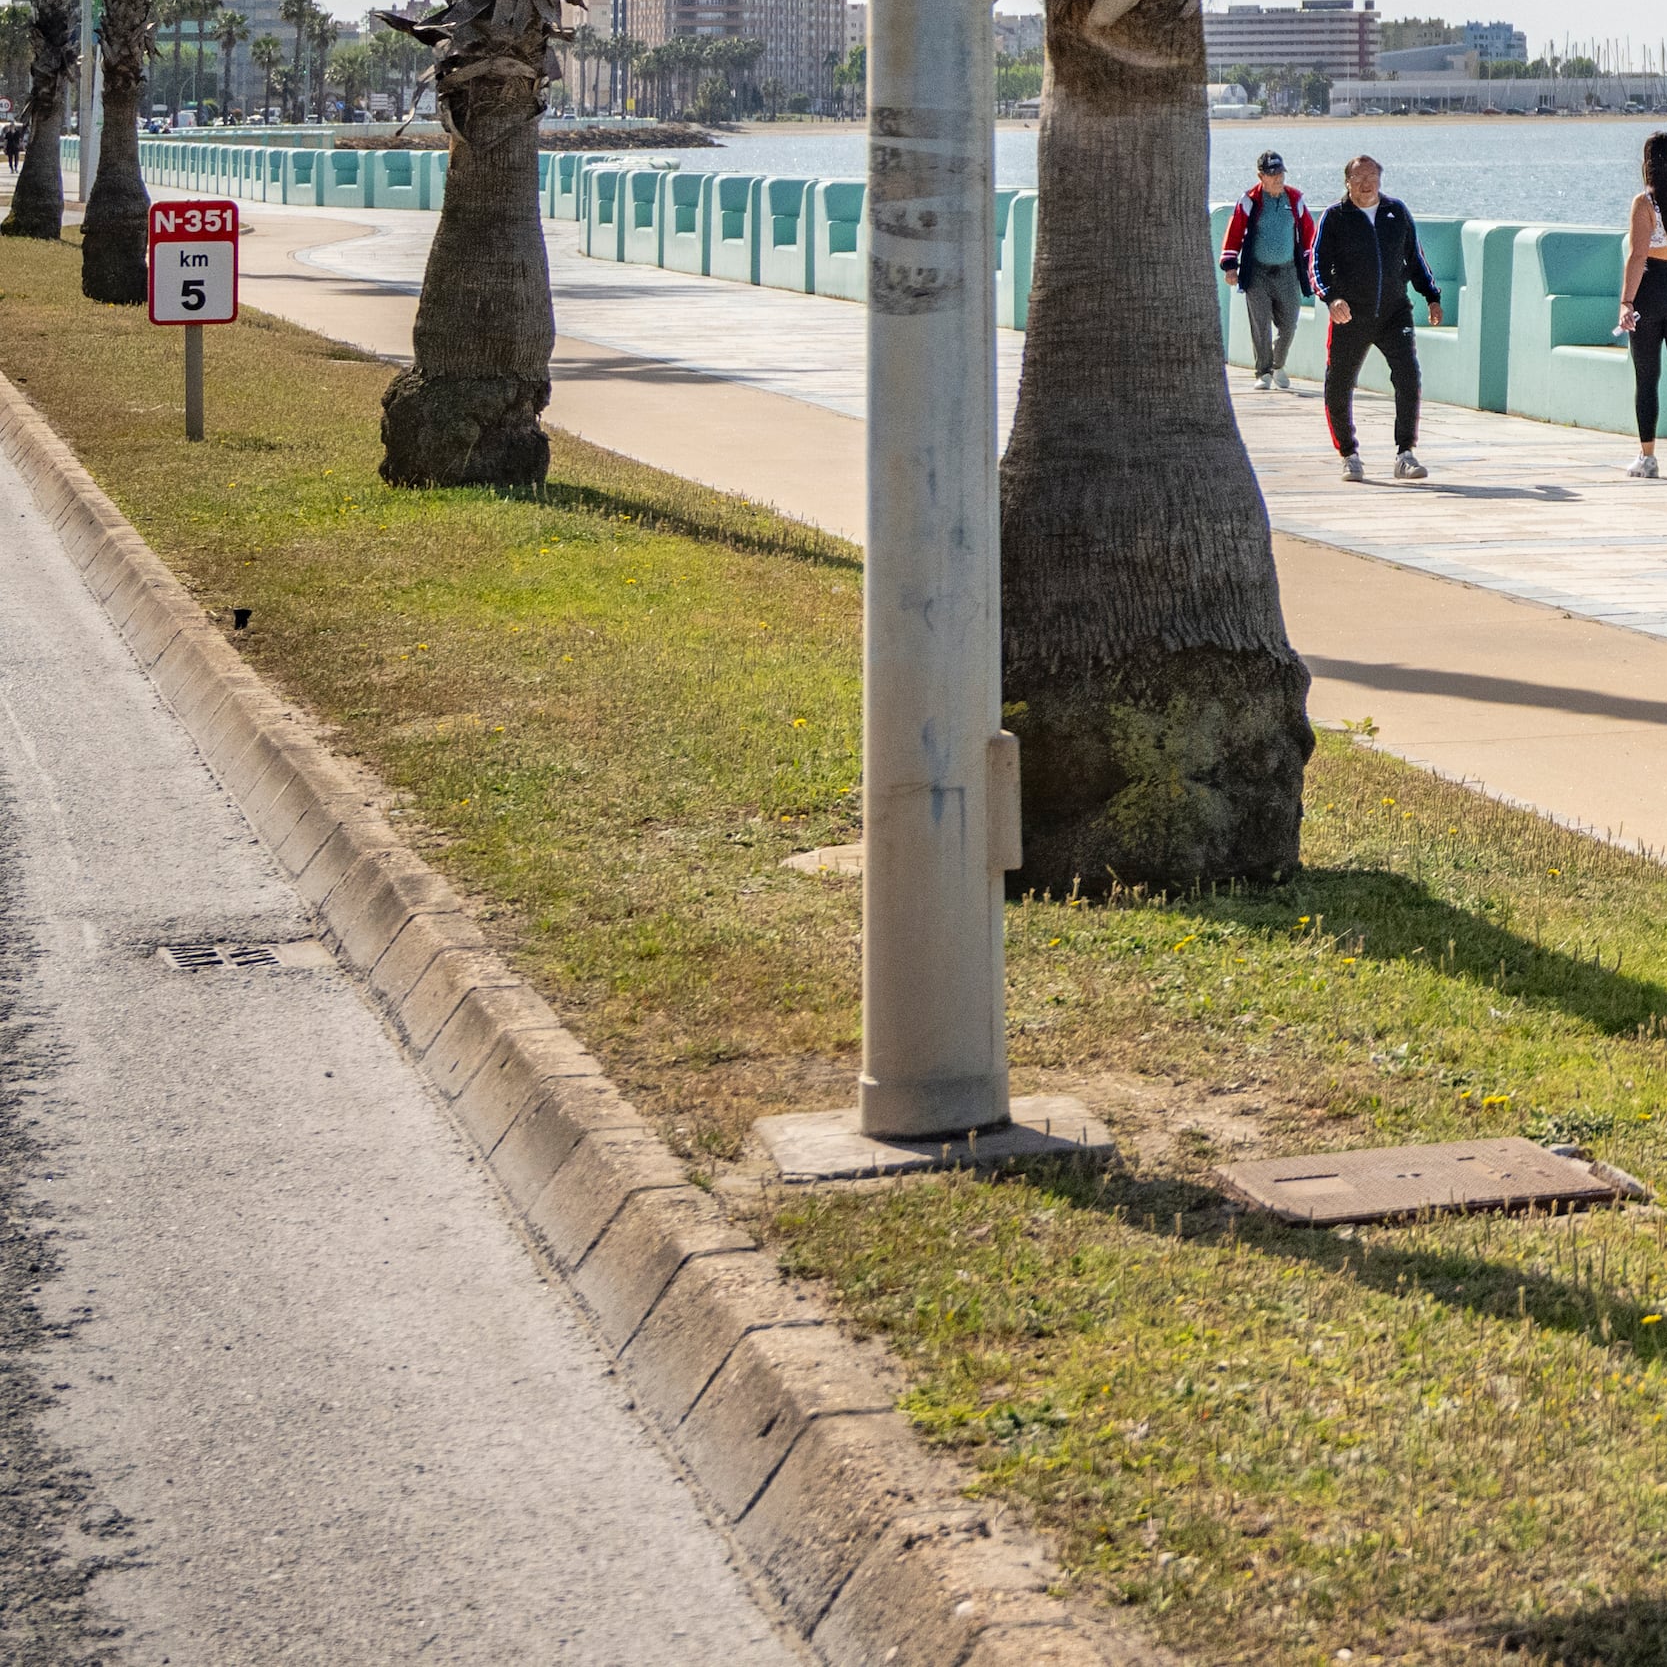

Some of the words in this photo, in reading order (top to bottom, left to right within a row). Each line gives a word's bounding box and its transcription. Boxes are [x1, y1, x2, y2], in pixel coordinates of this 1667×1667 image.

[154, 209, 233, 233] N-351
[180, 250, 208, 267] km
[181, 279, 206, 311] 5
